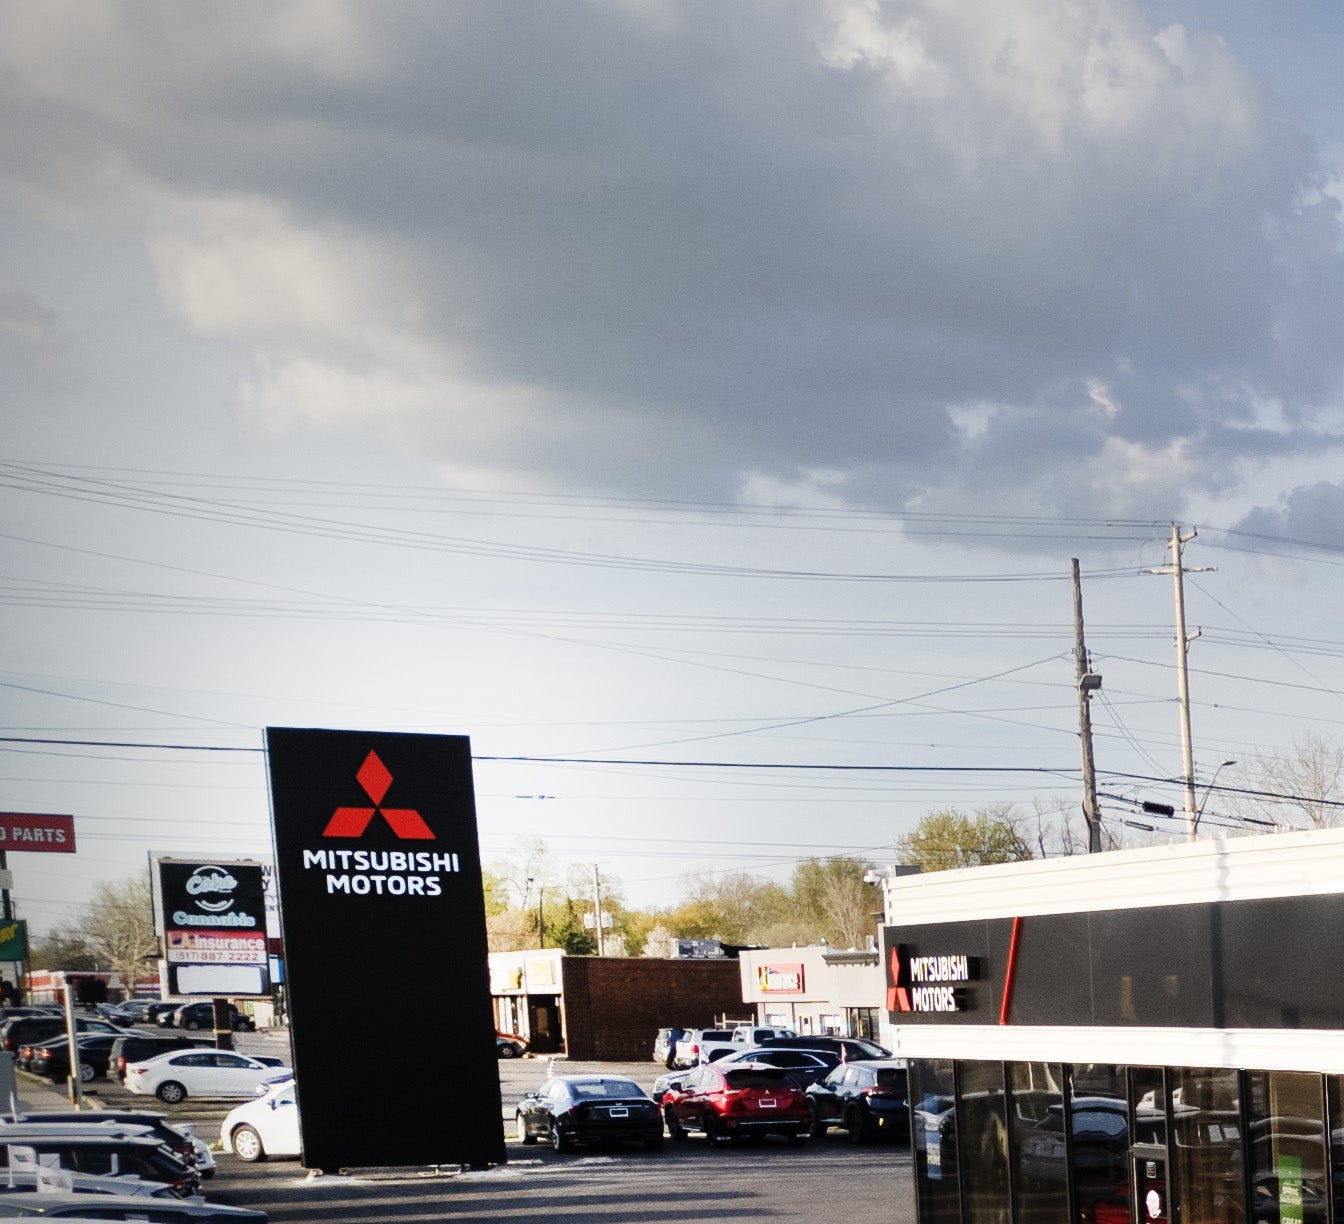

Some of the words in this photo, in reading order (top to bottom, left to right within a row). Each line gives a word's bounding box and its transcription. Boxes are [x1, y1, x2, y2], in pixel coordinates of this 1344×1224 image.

[13, 827, 67, 843] PARTS
[303, 849, 460, 872] MITSUBISHI
[186, 872, 238, 895] Cake
[326, 874, 442, 896] MOTORS
[173, 910, 257, 927] Cannabis
[194, 935, 265, 950] Insurance
[910, 955, 969, 982] MITSUBISHI
[912, 986, 956, 1012] MOTORS
